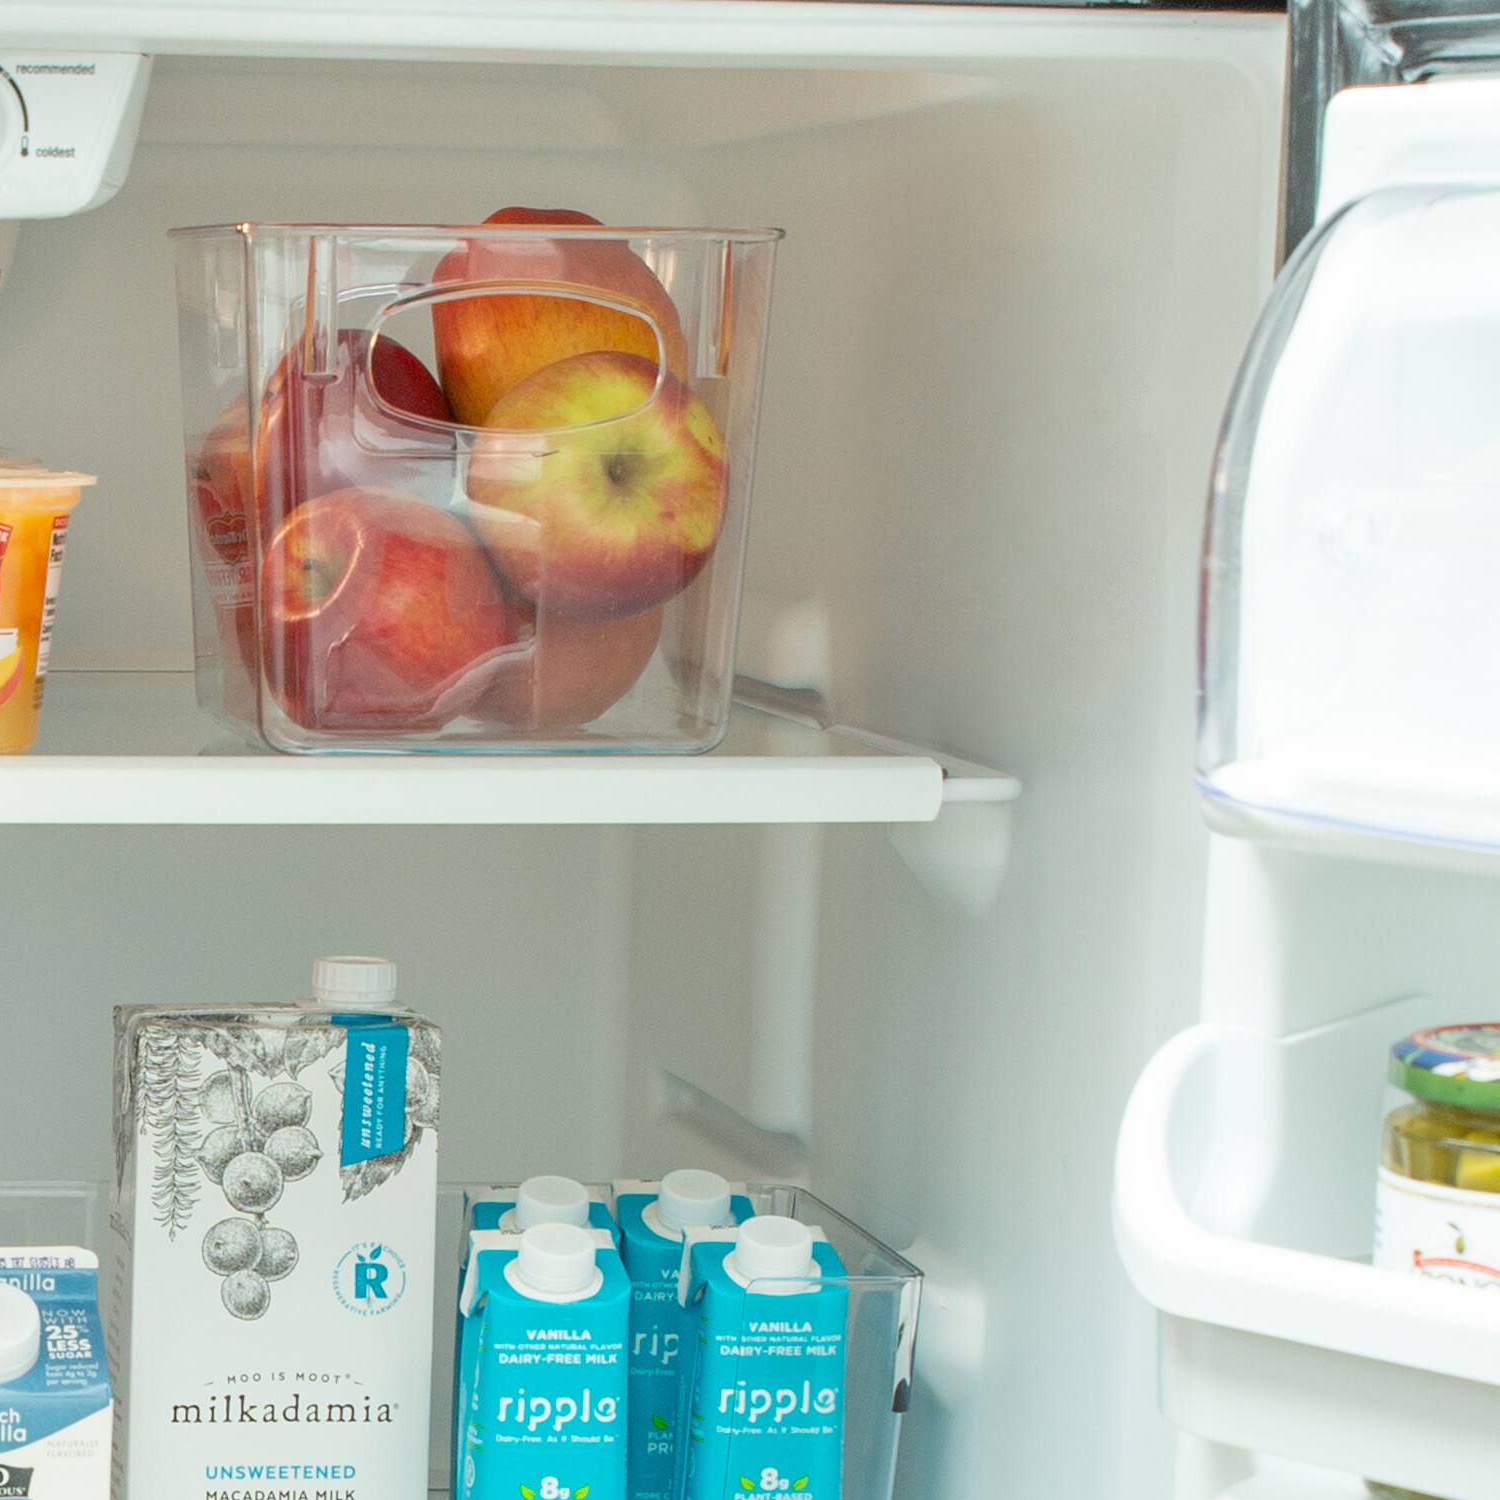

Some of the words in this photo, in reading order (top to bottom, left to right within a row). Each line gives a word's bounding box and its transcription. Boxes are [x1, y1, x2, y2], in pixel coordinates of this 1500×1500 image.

[16, 63, 95, 76] recommended
[35, 147, 75, 158] coldest
[378, 1045, 388, 1094] ANYTHING
[361, 1041, 376, 1150] unsweetened
[375, 1118, 384, 1149] READY
[41, 1308, 86, 1318] NOW
[43, 1317, 88, 1325] WITH
[748, 1321, 813, 1333] VANILLA
[526, 1329, 592, 1341] VANILLA
[47, 1338, 92, 1353] LESS
[719, 1344, 802, 1357] DAIRY-FREE
[806, 1344, 837, 1356] MILK
[48, 1350, 93, 1360] SUGAR
[498, 1353, 582, 1366] DAIRY-FREE
[585, 1353, 618, 1365] MILK
[227, 1373, 262, 1385] MOO
[270, 1371, 286, 1382] IS
[170, 1393, 394, 1424] milkadamia
[717, 1379, 837, 1424] ripple
[497, 1387, 617, 1432] ripple
[205, 1464, 357, 1480] UNSWEETENED
[759, 1467, 790, 1492] 8g
[539, 1475, 571, 1500] 8g
